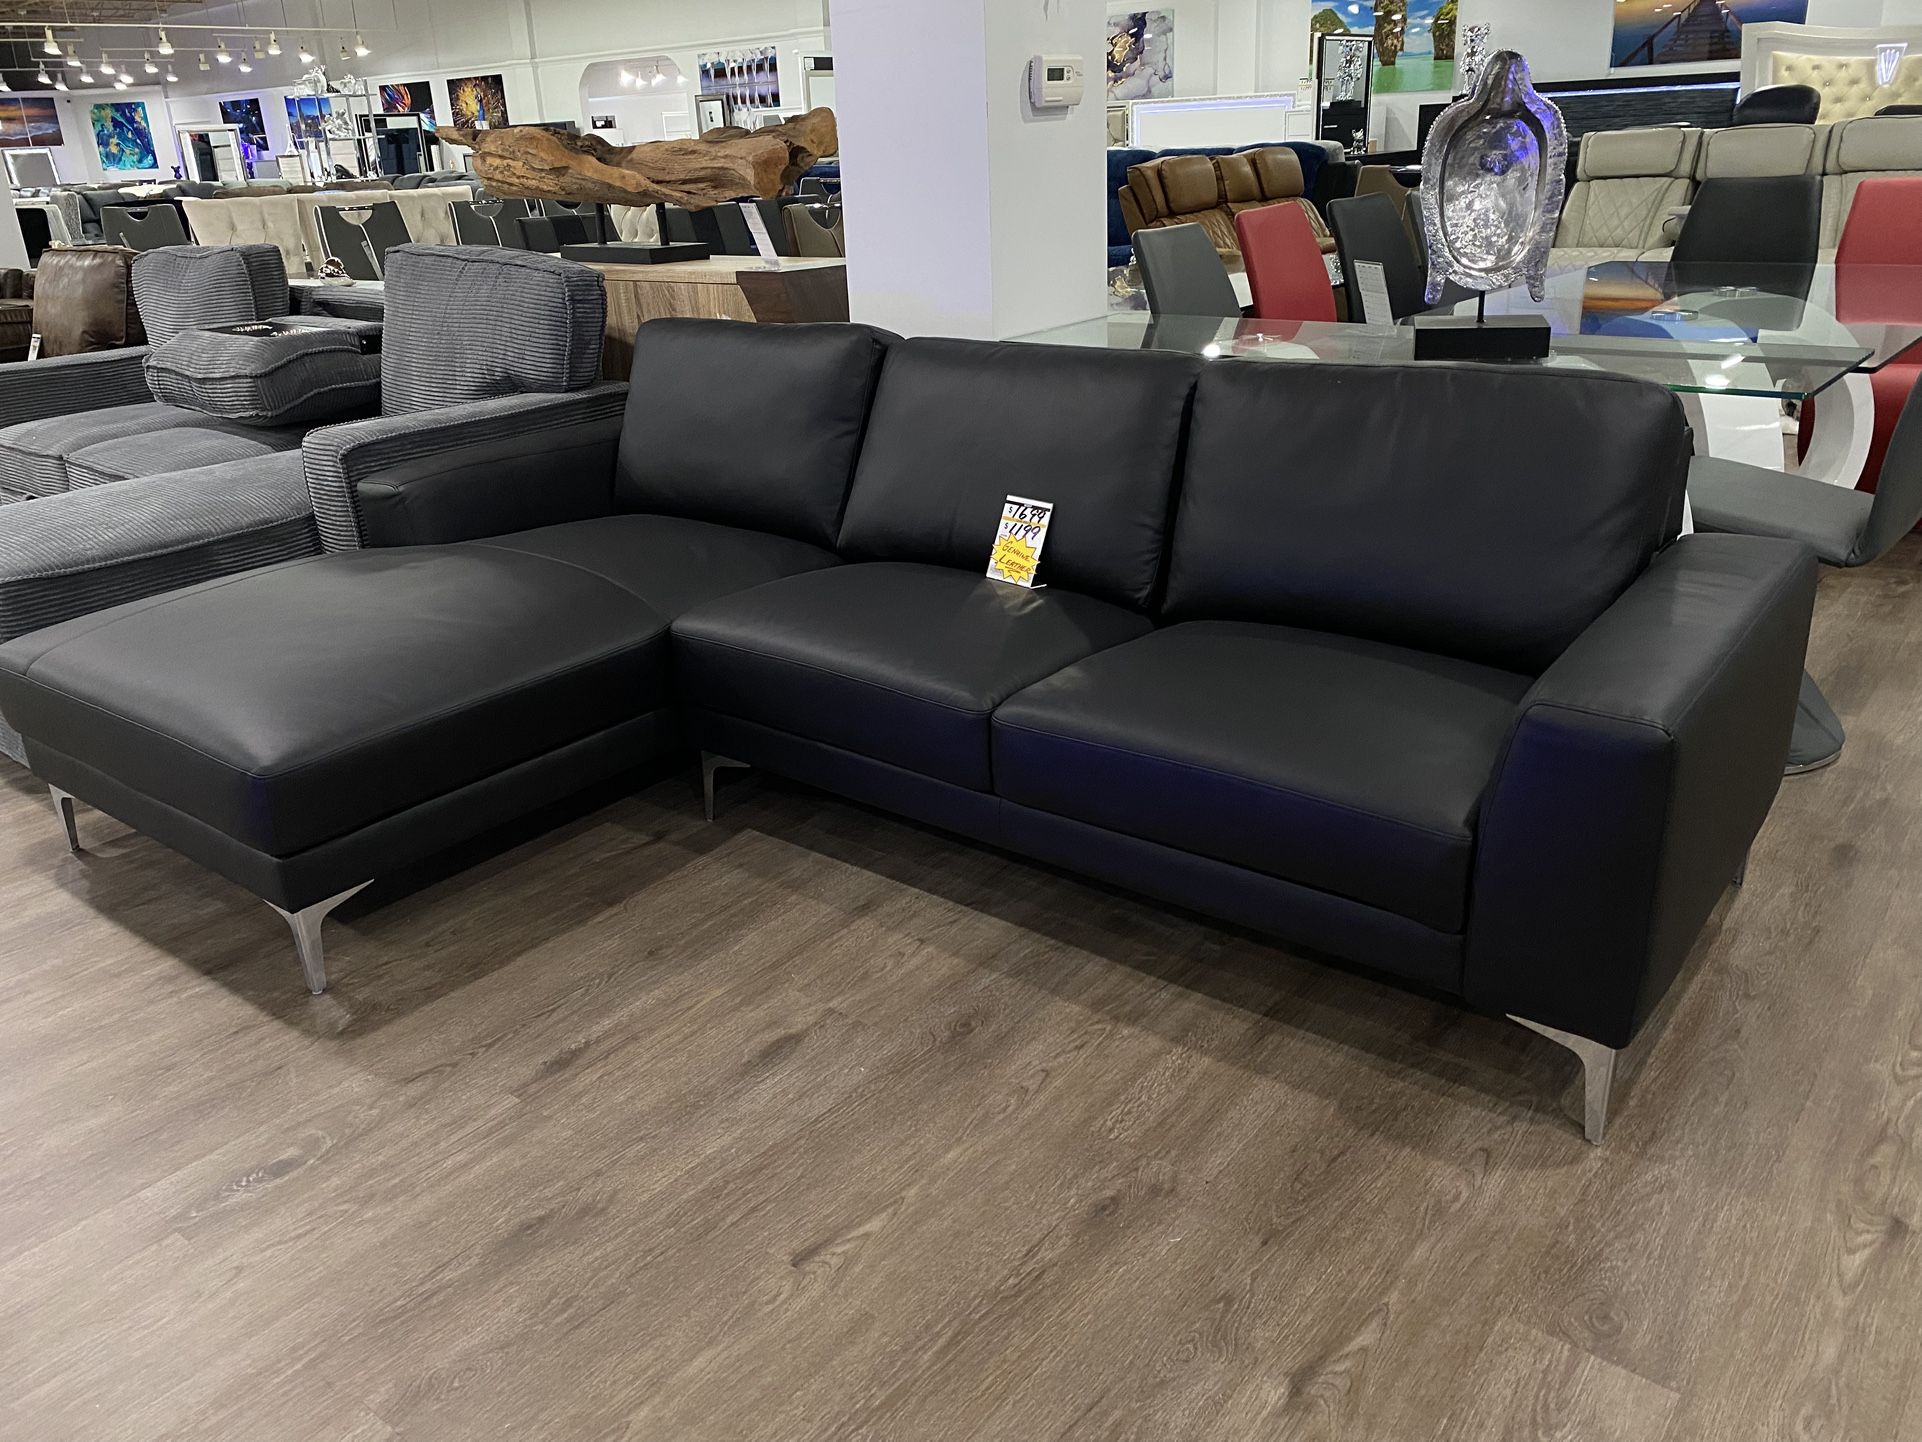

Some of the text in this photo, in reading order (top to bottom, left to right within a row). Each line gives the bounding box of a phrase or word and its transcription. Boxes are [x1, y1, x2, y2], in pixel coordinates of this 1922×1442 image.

[1004, 522, 1041, 540] $1199
[1002, 541, 1030, 562] GENUINE
[999, 554, 1031, 573] LEATHER
